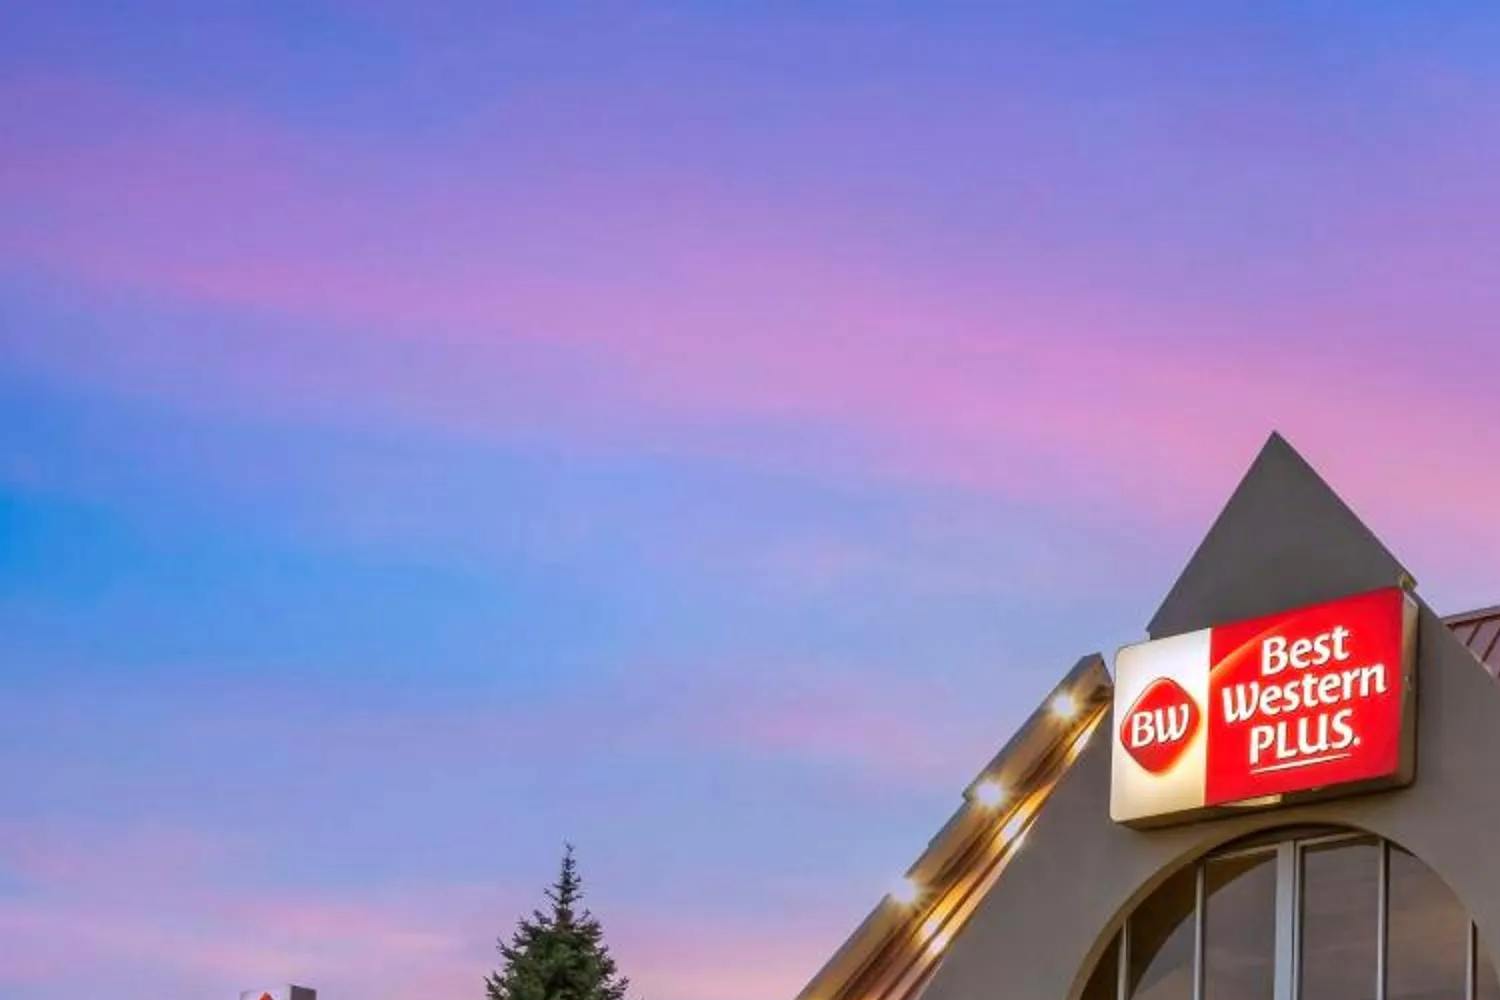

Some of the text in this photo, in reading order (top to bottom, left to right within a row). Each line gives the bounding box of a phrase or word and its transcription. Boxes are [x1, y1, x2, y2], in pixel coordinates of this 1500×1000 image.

[1262, 626, 1351, 675] Best
[1222, 664, 1386, 723] Western
[1131, 705, 1189, 747] BW
